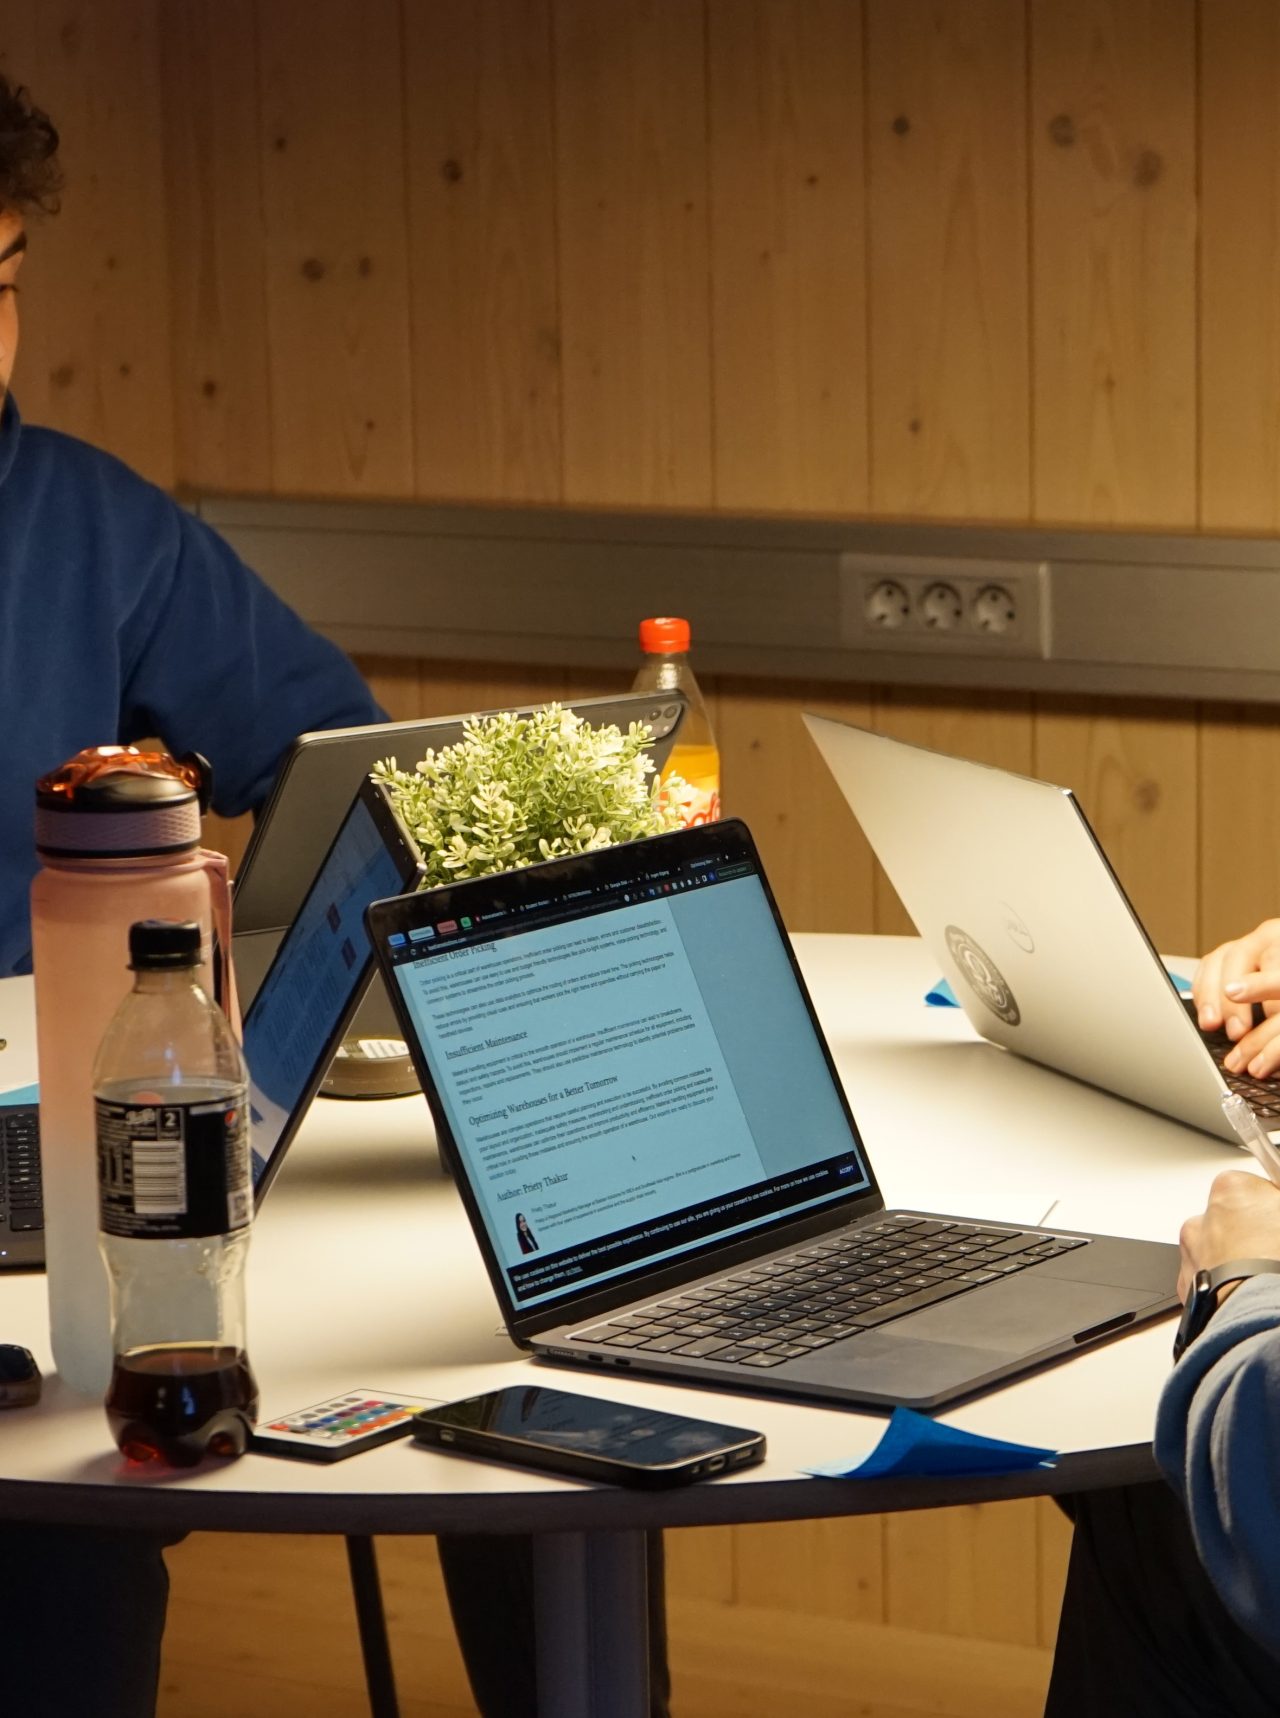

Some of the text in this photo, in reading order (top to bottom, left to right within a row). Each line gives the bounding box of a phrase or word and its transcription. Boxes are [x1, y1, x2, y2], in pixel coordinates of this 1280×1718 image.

[413, 942, 497, 969] Inefficient Order Picking
[445, 1032, 528, 1059] Insufficient Maintenance
[468, 1108, 508, 1127] Optimizing
[507, 1097, 547, 1113] Warehouses
[548, 1093, 558, 1101] for
[564, 1085, 585, 1096] Better
[585, 1076, 618, 1090] Tomorrow
[164, 1112, 176, 1127] 2
[496, 1173, 569, 1202] Author: Priety Thakur
